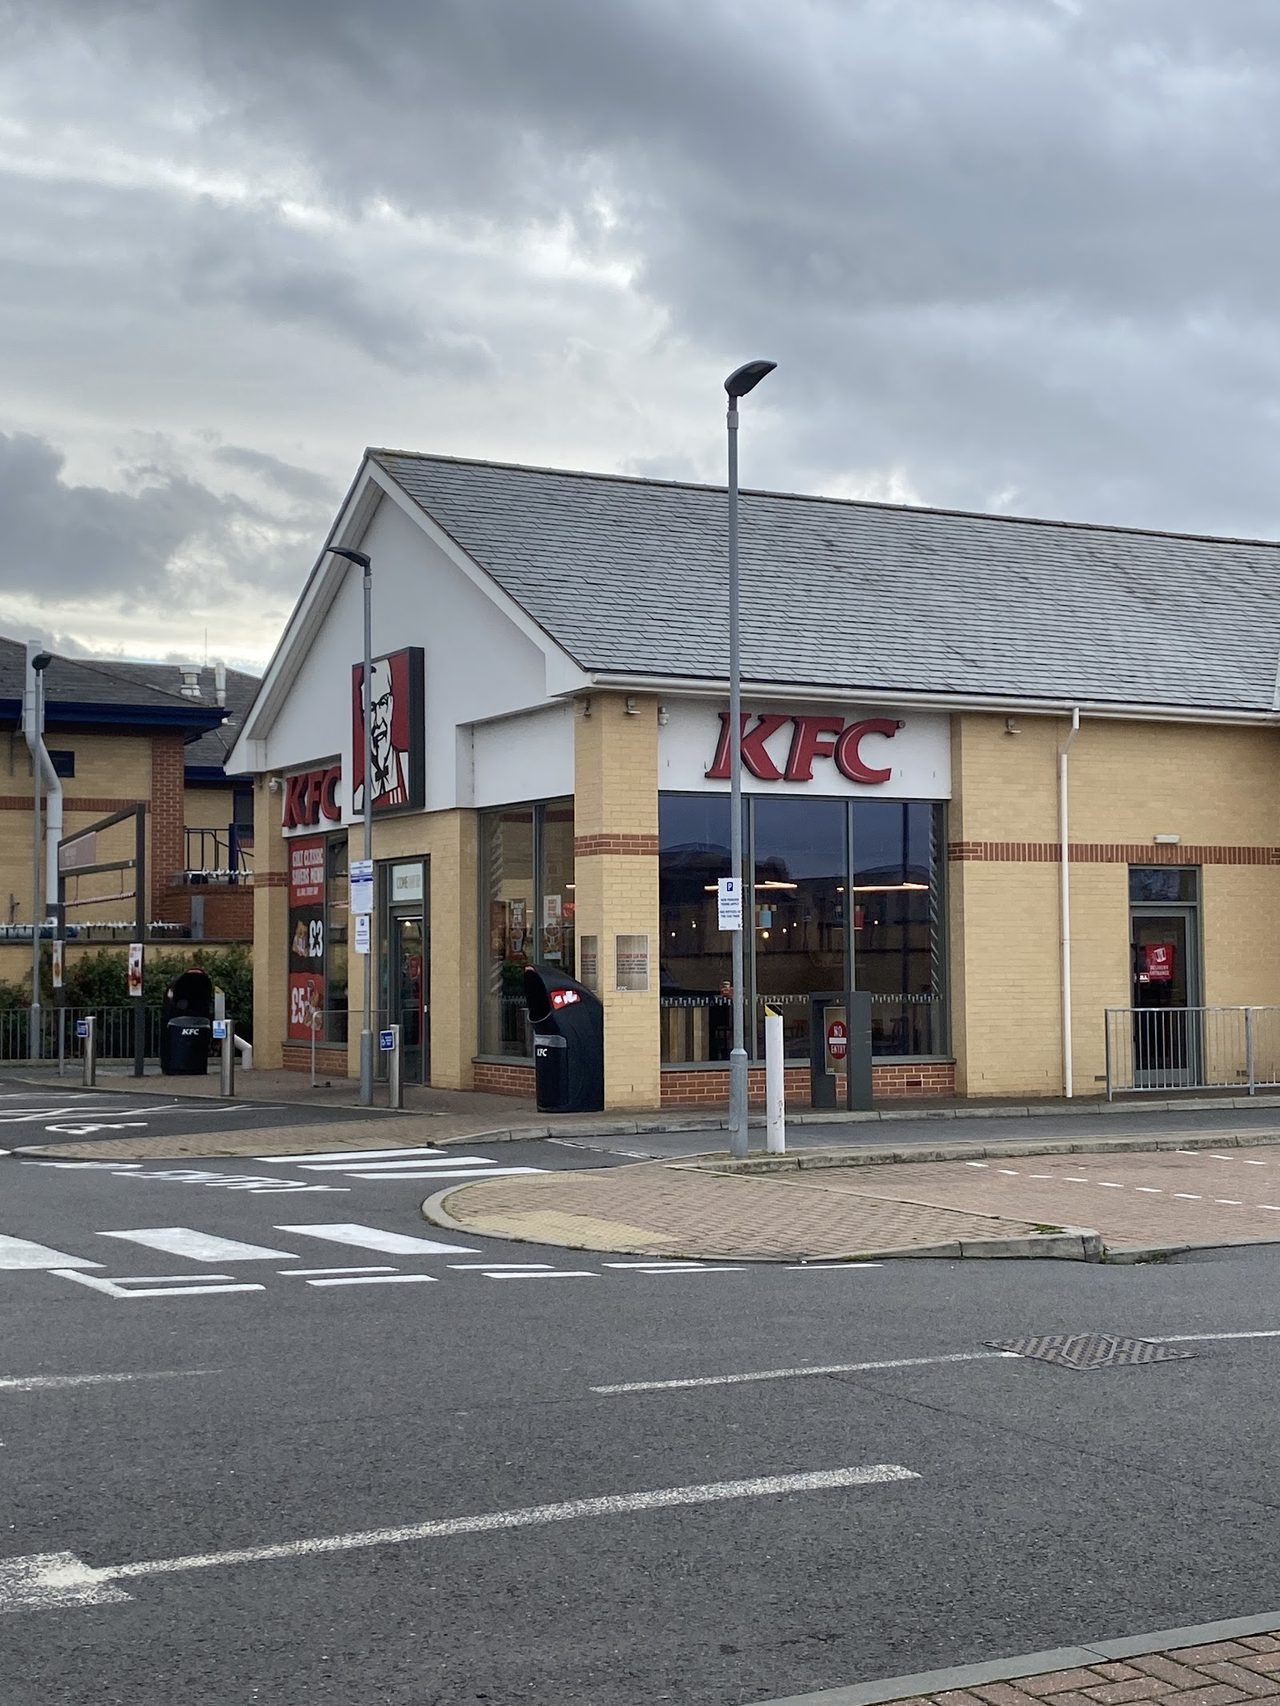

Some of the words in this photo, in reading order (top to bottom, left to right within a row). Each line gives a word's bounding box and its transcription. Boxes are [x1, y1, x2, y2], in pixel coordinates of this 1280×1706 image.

[704, 712, 899, 784] KFC
[282, 767, 342, 828] KFC
[309, 920, 323, 957] £3
[182, 1028, 200, 1036] KFC
[833, 1025, 843, 1037] NO
[536, 1048, 548, 1057] KFC
[111, 1169, 352, 1193] ENTRY
